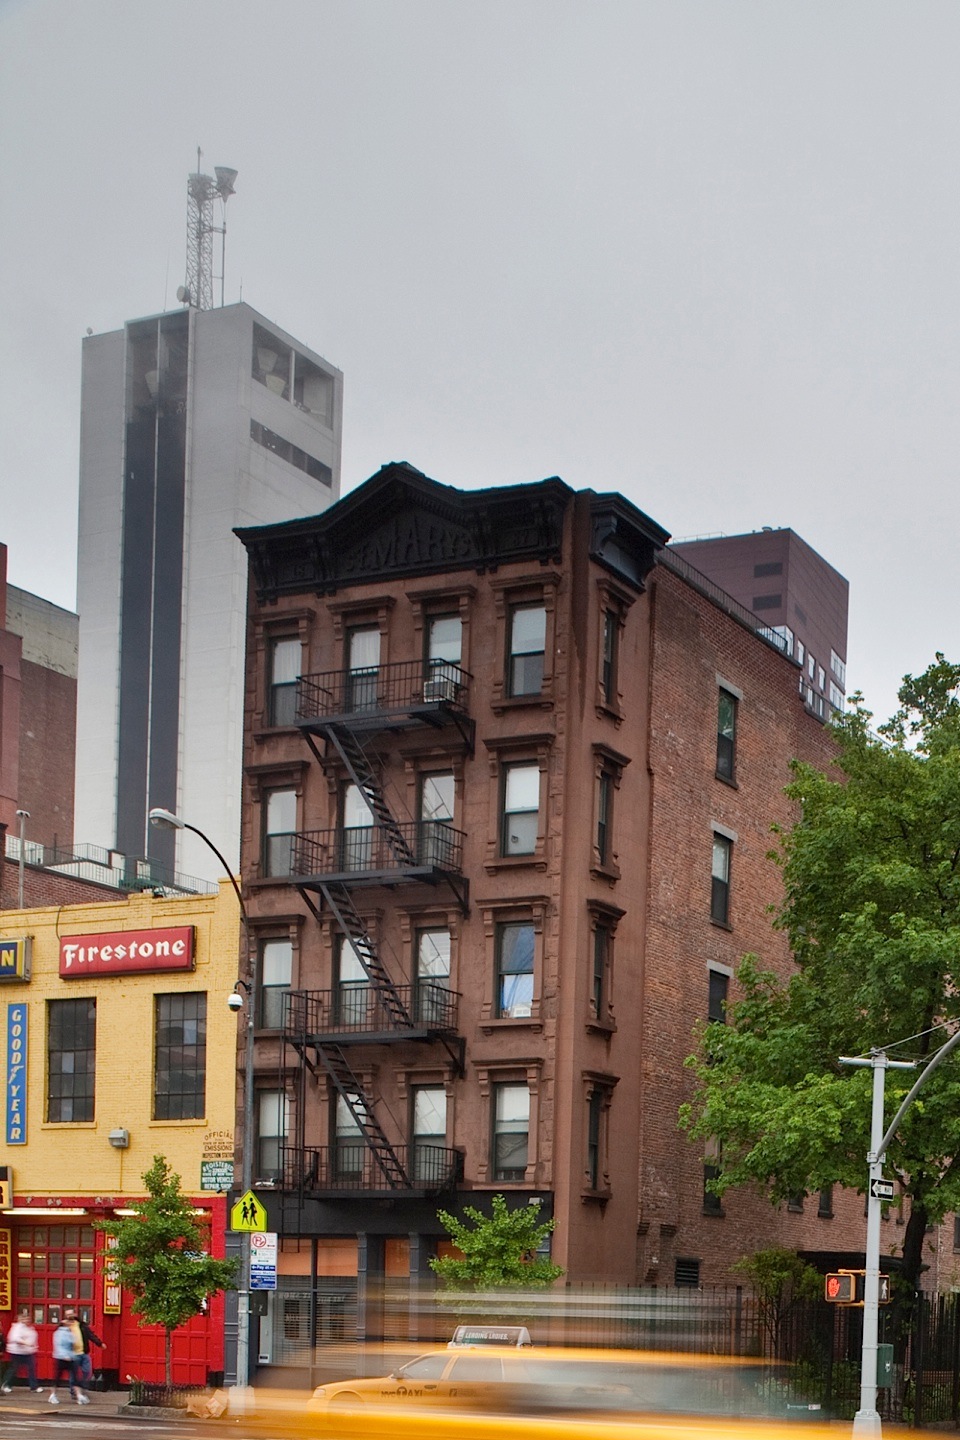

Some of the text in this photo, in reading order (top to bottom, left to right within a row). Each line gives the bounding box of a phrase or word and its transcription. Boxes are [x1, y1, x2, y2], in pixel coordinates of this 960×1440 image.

[62, 939, 185, 969] Firestone
[10, 1009, 23, 1140] GOODYEAR
[204, 1131, 233, 1140] OFFICIAL
